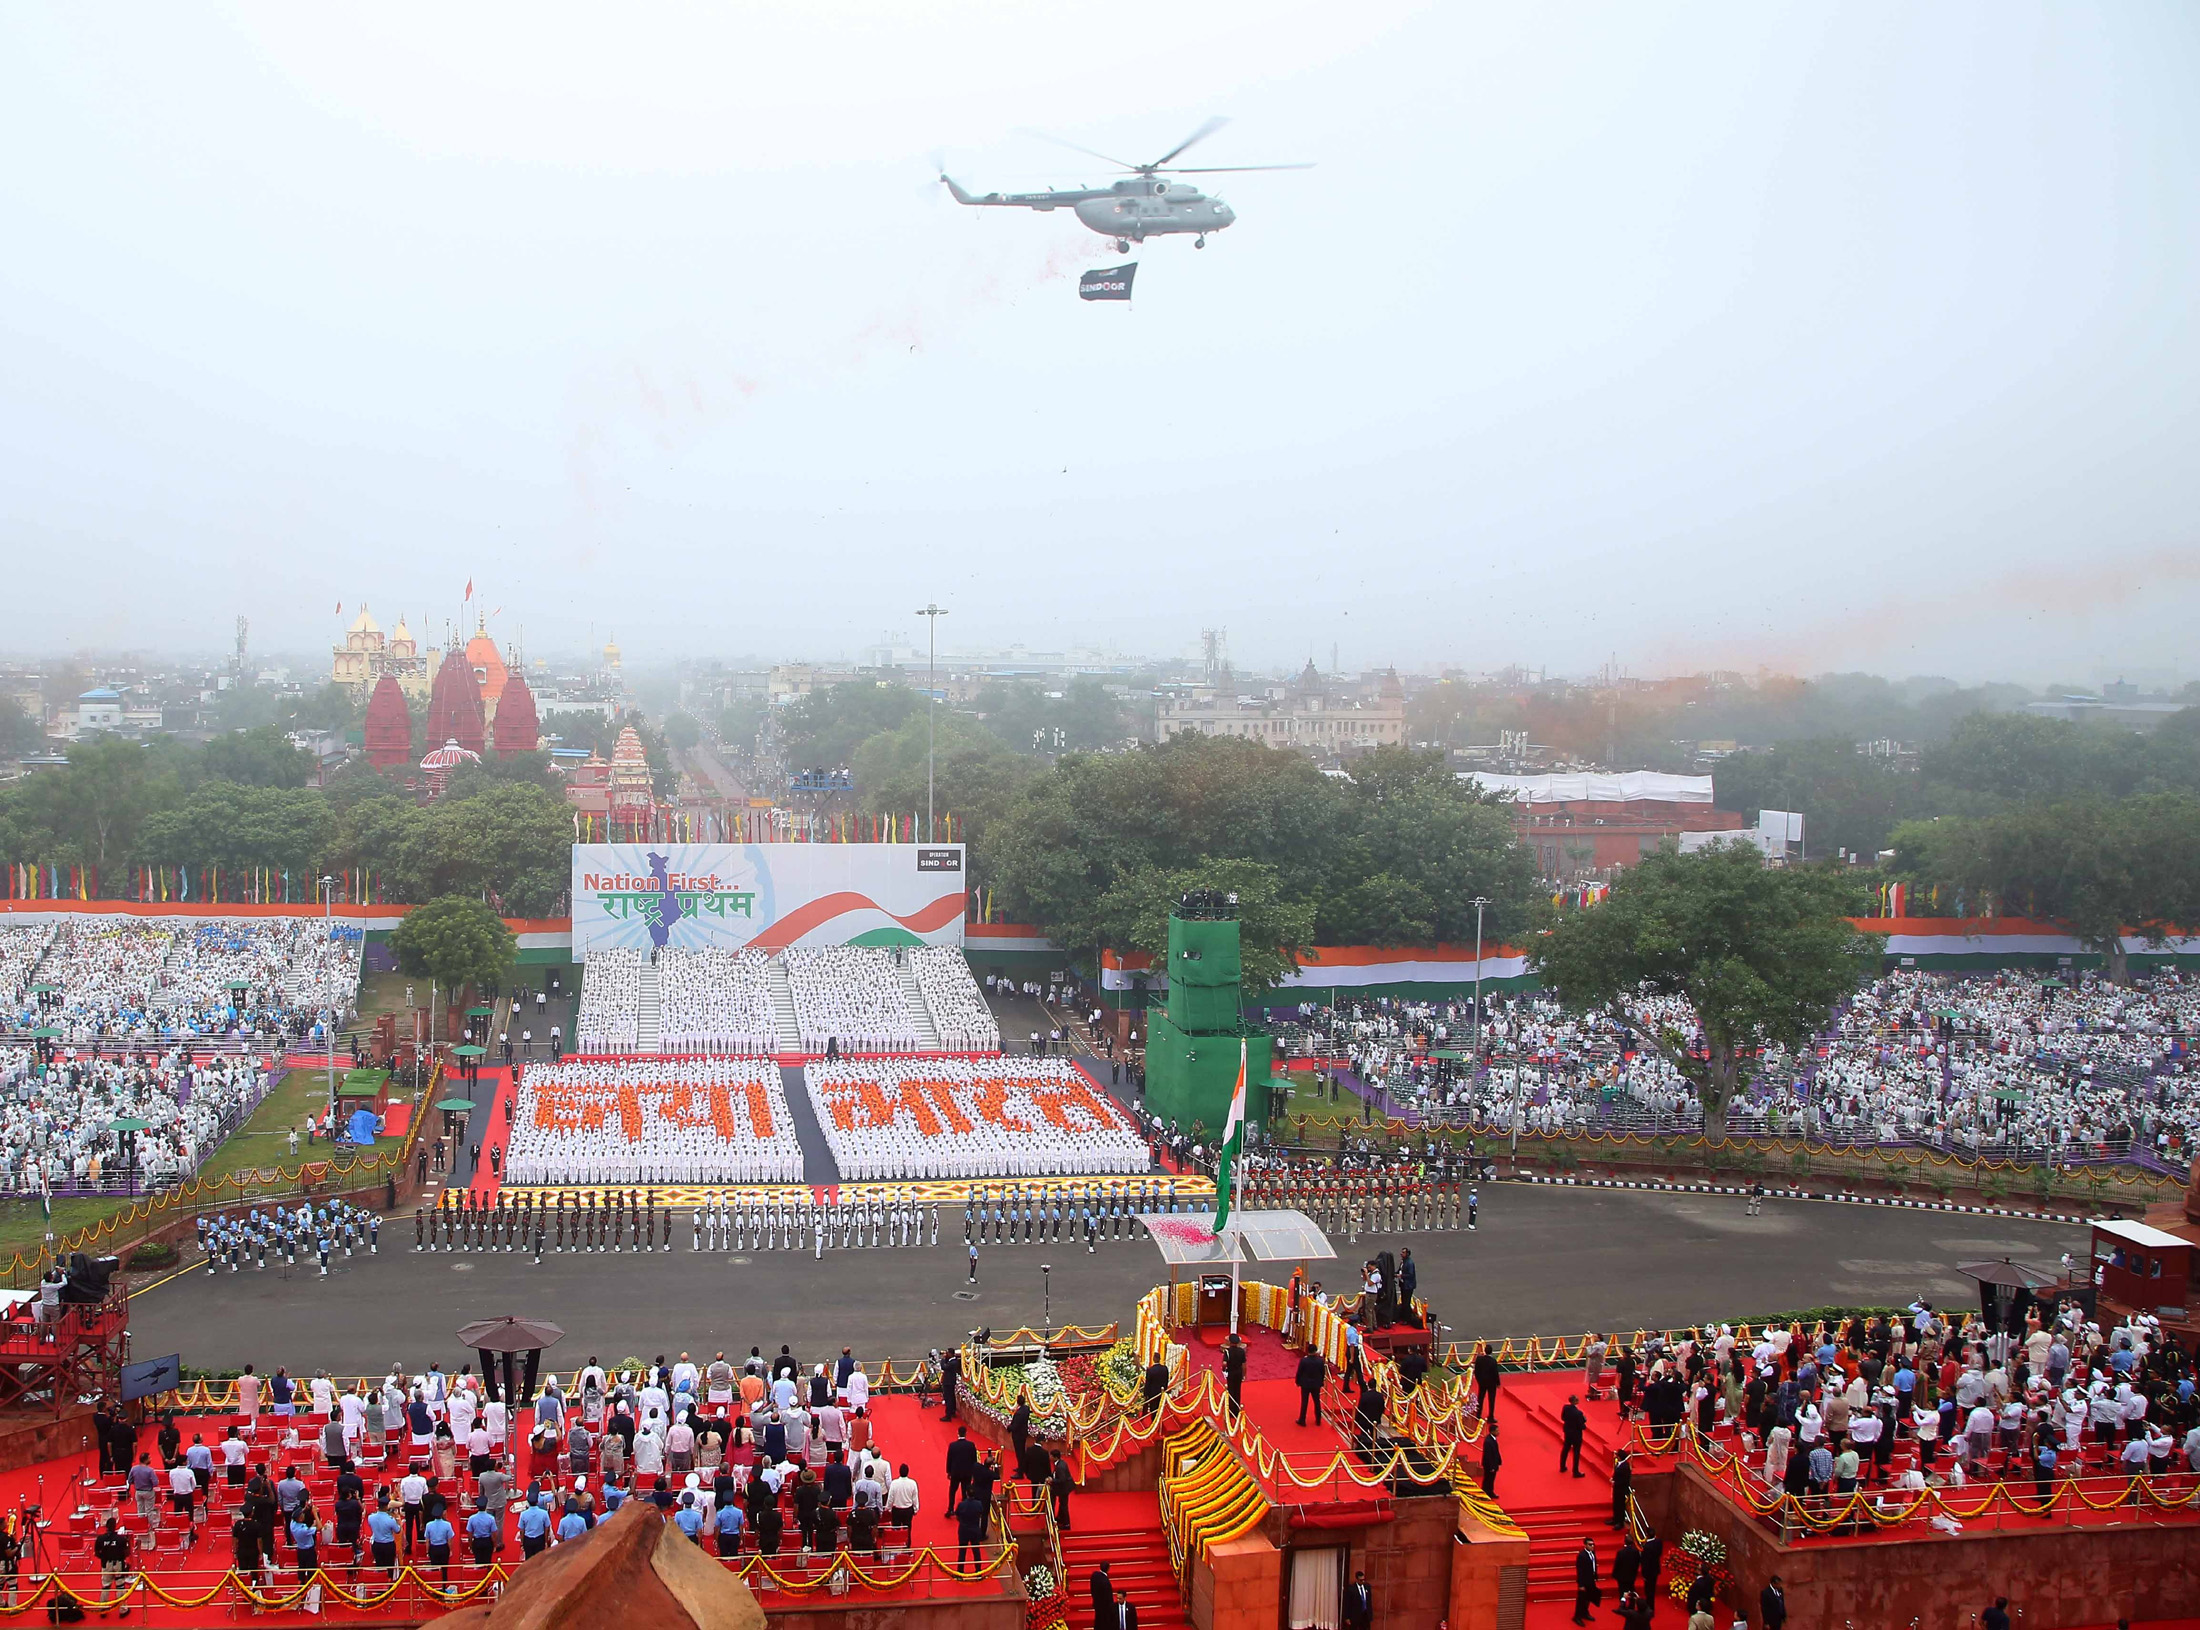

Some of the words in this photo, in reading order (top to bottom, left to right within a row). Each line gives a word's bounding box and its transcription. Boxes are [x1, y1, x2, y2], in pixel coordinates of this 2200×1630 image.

[1080, 282, 1125, 292] SINDOOR
[583, 873, 660, 891] Nation
[668, 873, 740, 891] First...
[596, 892, 666, 928] राष्ट्र
[675, 892, 757, 920] प्रथम
